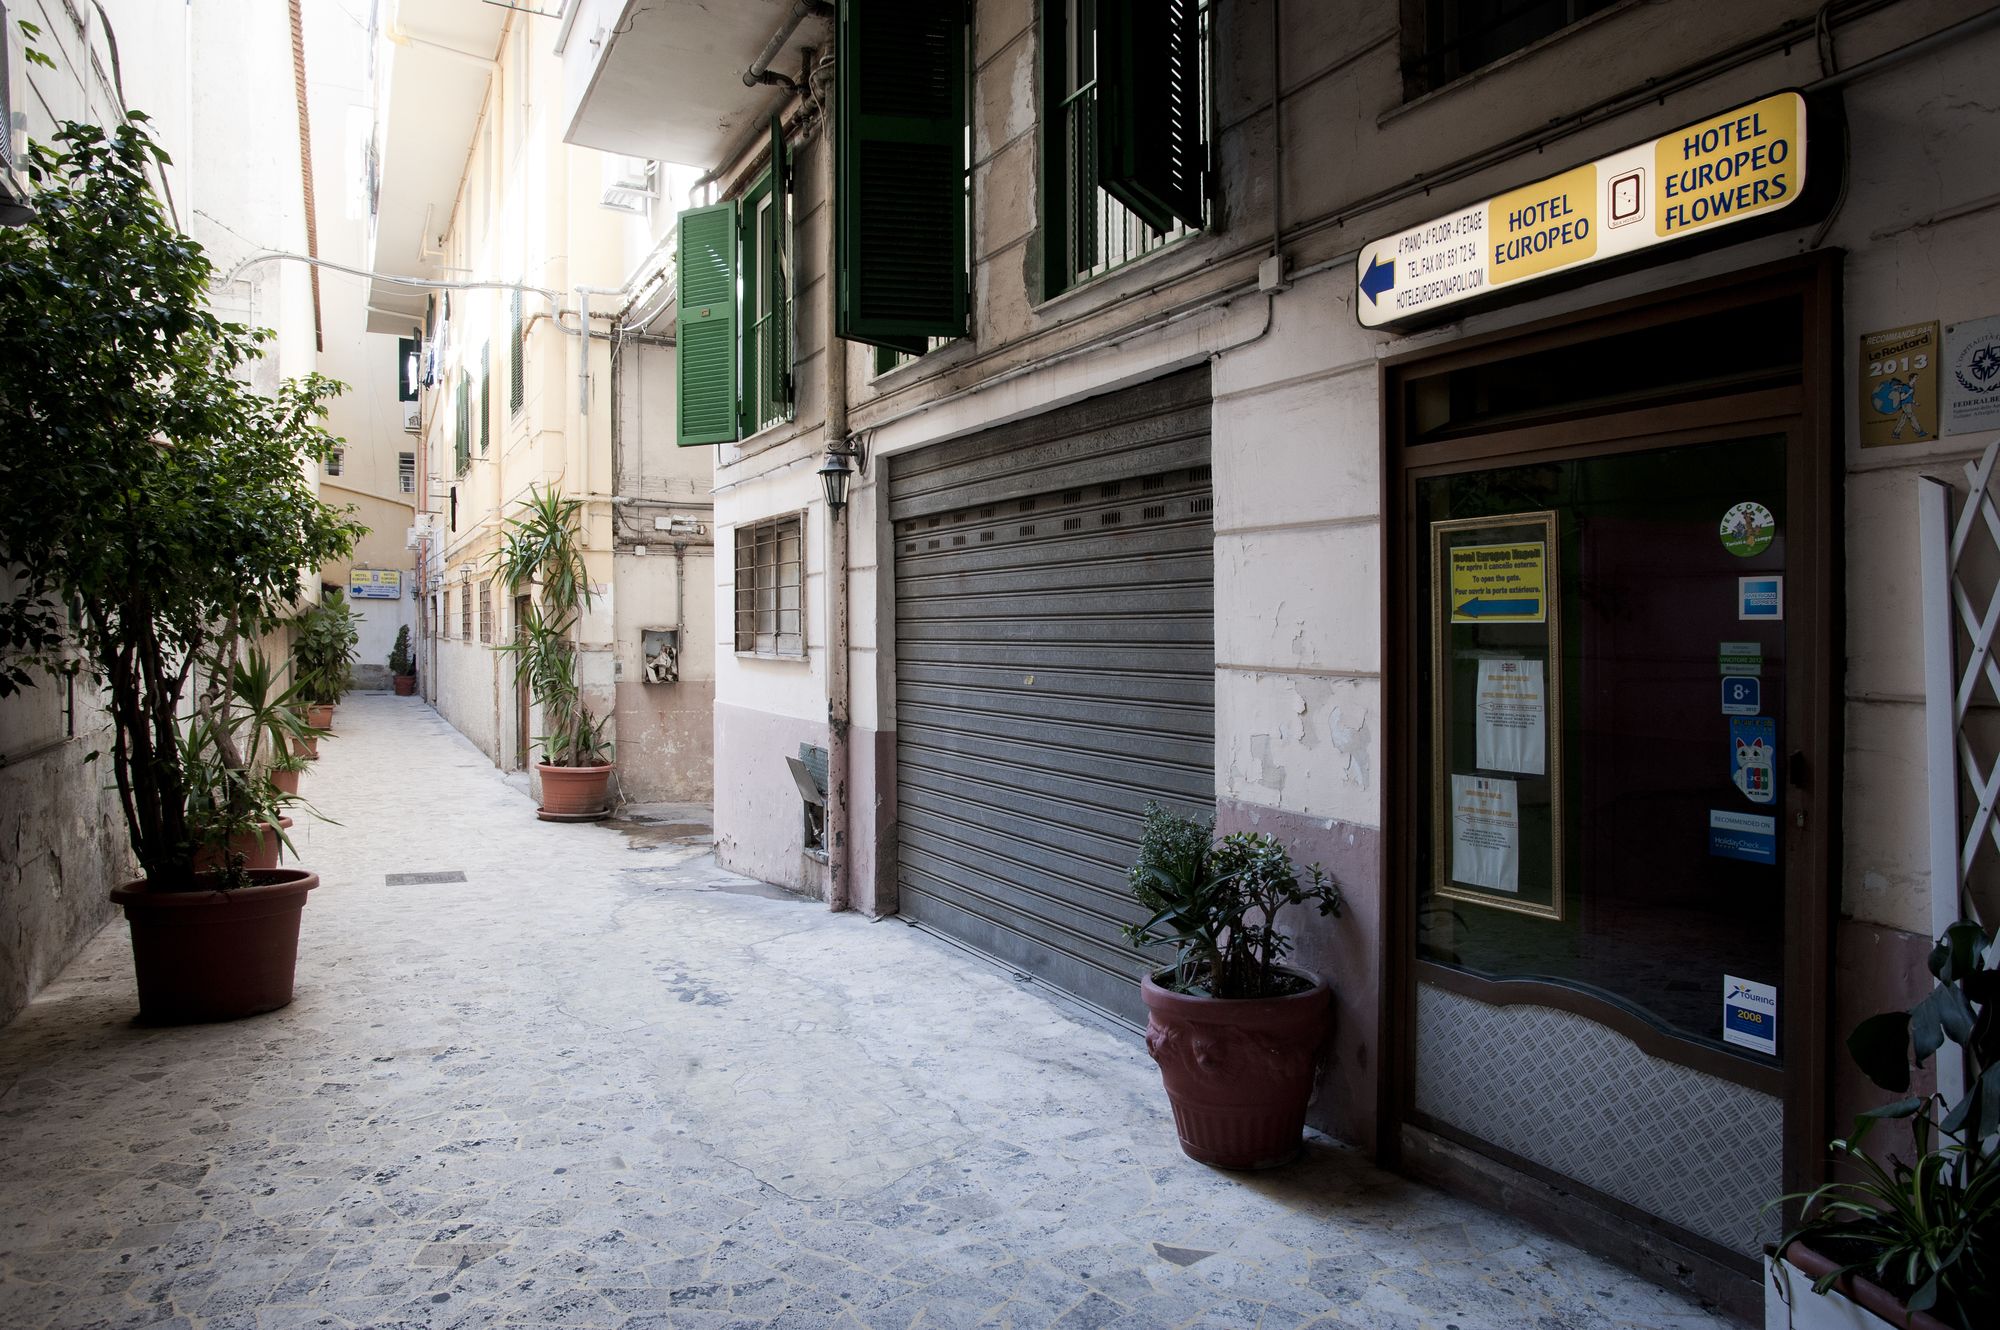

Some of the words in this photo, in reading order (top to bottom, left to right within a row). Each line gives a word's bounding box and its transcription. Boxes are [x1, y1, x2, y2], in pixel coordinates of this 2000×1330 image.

[1683, 112, 1767, 160] HOTEL
[1665, 139, 1788, 198] EUROPEO
[1508, 194, 1574, 233] HOTEL
[1665, 174, 1787, 230] FLOWERS
[1405, 232, 1421, 254] PIANO
[1431, 222, 1452, 245] FLOOR
[1463, 211, 1482, 234] ETAGE
[1495, 217, 1589, 265] EUROPEO
[1435, 252, 1446, 271] 081
[1447, 247, 1458, 267] 551
[1459, 244, 1467, 263] 72
[1468, 241, 1476, 260] 54
[1396, 267, 1484, 310] HOTELEUROPEONAPOLI.COM
[1868, 350, 1881, 362] Le
[1881, 334, 1929, 358] Routard
[1869, 354, 1928, 377] 2013
[1721, 503, 1774, 534] WELCOME!
[1466, 564, 1483, 572] aprire
[1480, 575, 1495, 583] open
[1492, 587, 1508, 595] porte
[1733, 684, 1751, 700] 8+
[1714, 815, 1760, 827] RECOMMENDED
[1714, 836, 1760, 849] HolidayCheck
[1740, 991, 1775, 1006] TOURING
[1737, 1009, 1763, 1024] 2008
